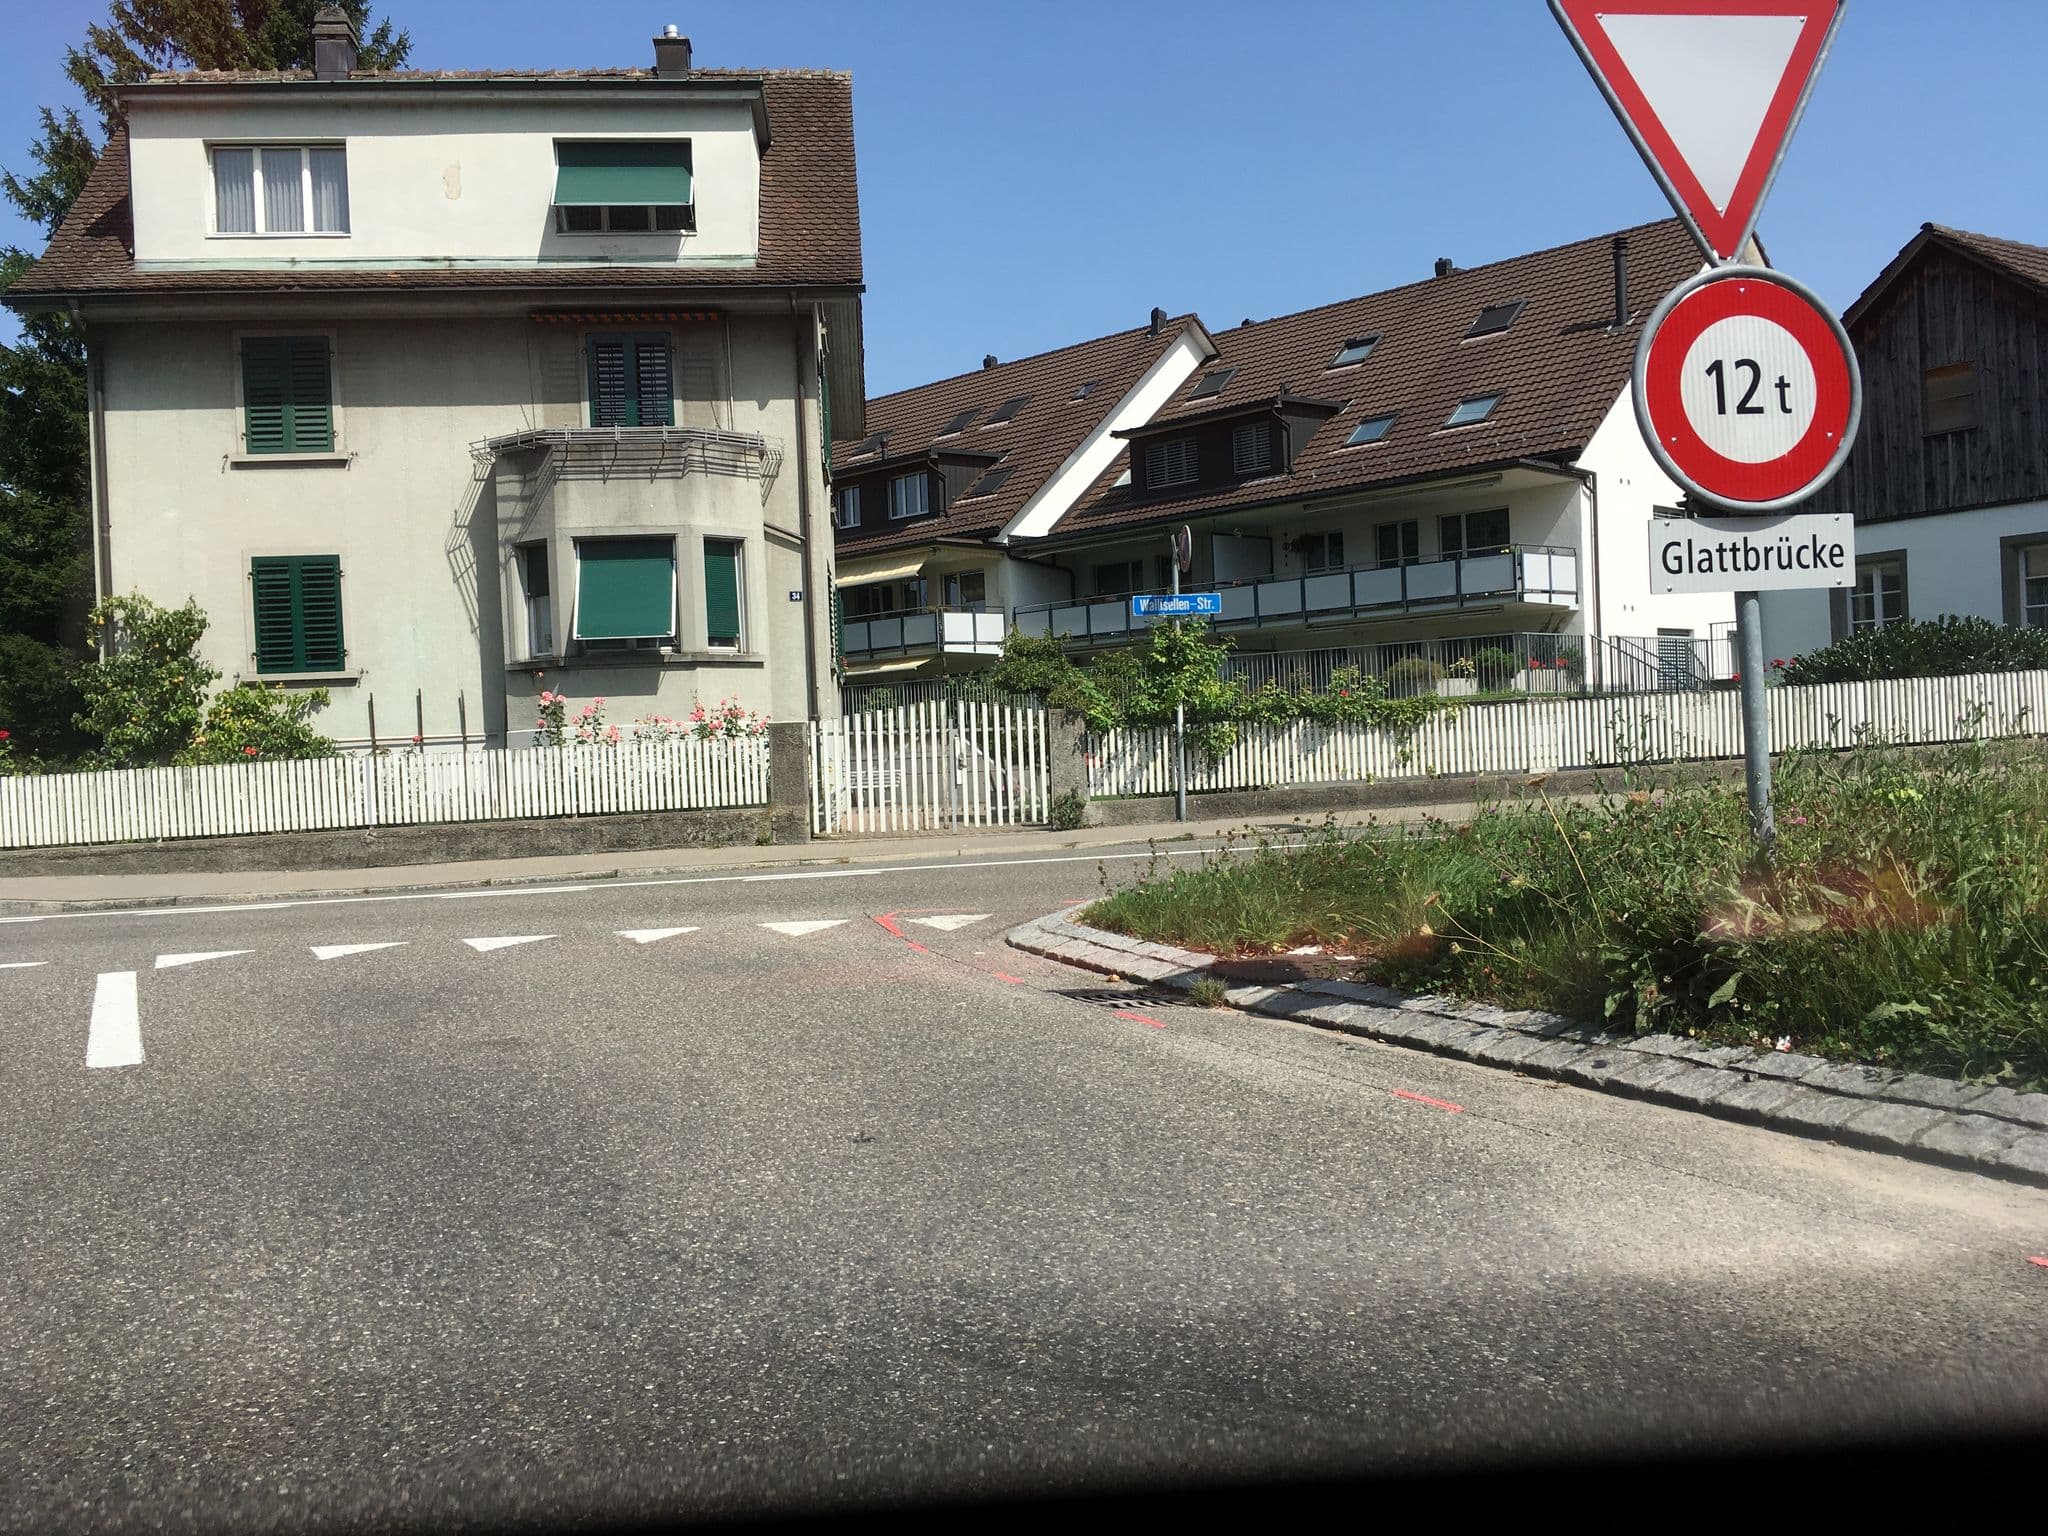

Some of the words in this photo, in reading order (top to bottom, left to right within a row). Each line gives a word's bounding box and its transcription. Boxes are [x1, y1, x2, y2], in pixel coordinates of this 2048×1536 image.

[1705, 358, 1765, 415] 12
[1774, 375, 1793, 414] t
[1661, 533, 1845, 575] Glattbrücke
[791, 592, 801, 600] 34
